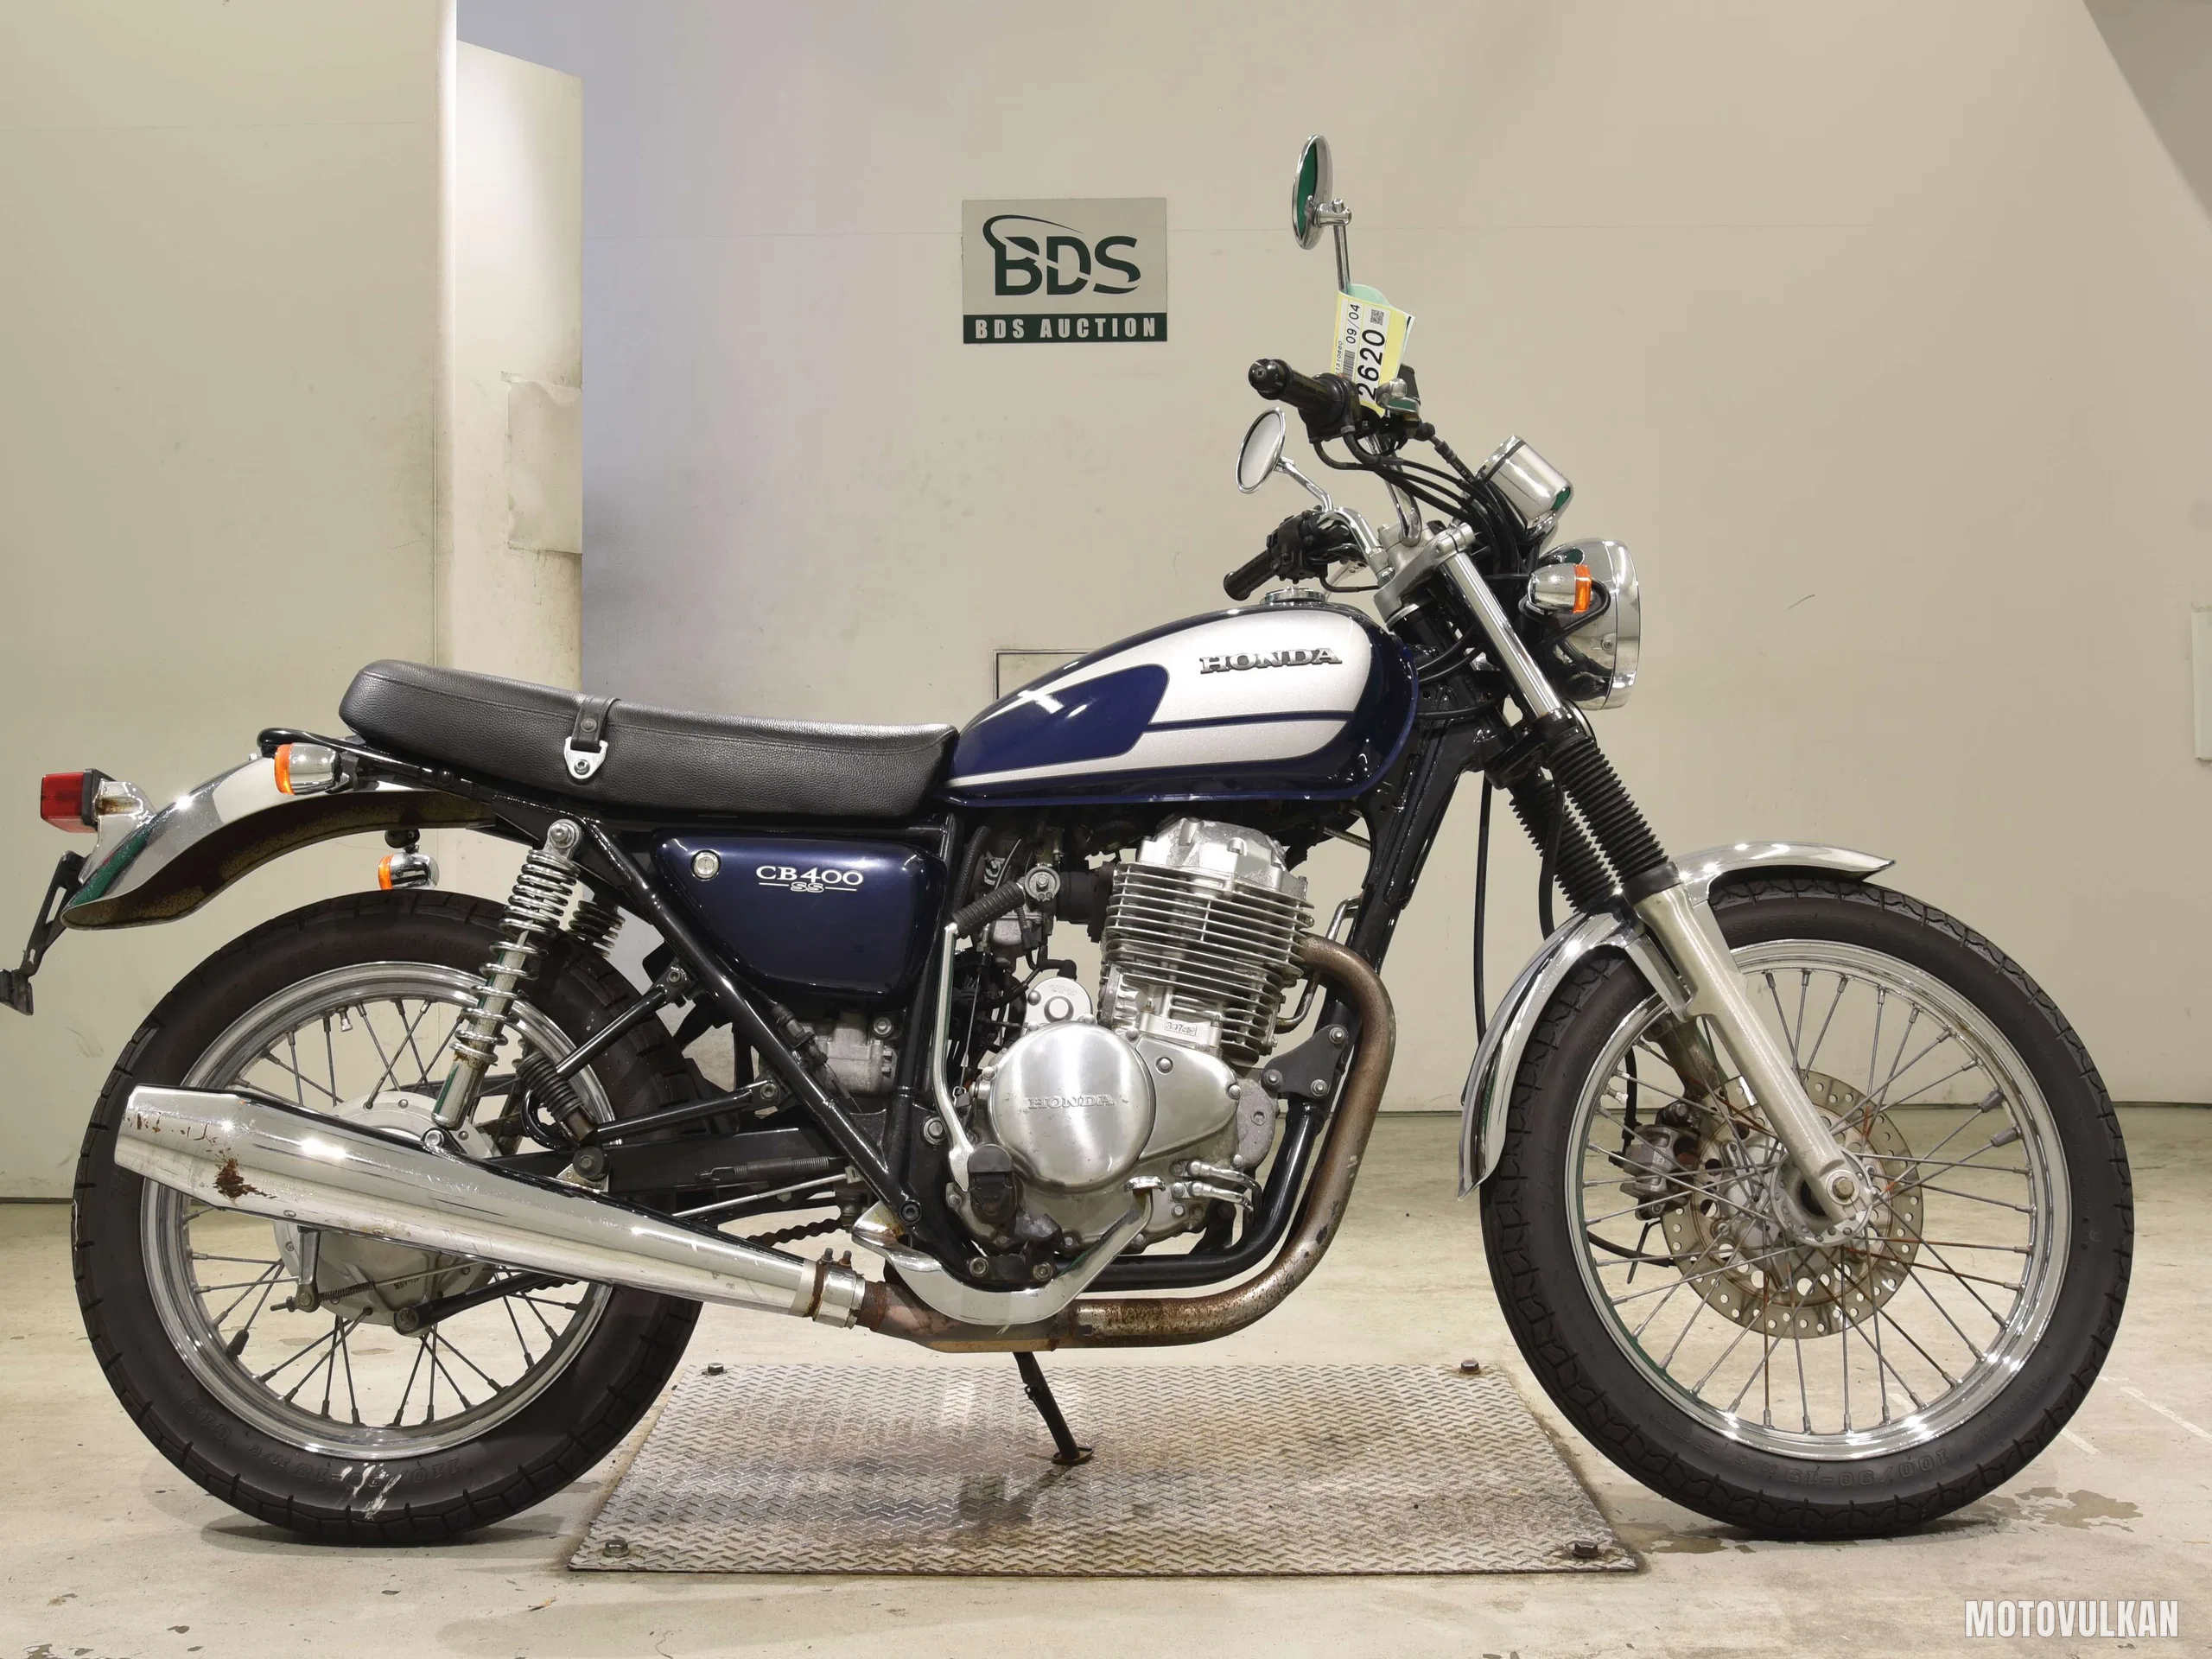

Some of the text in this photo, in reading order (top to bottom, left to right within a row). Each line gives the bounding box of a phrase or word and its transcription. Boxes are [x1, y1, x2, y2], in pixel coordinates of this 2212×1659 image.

[982, 214, 1141, 296] BDS
[975, 317, 1156, 339] BDS AUCTION
[1345, 304, 1360, 344] 09/04
[1356, 329, 1386, 401] 2620
[1199, 647, 1343, 674] HONDA
[756, 866, 863, 886] CB400
[791, 881, 824, 893] SS
[1027, 1094, 1116, 1109] HONDA
